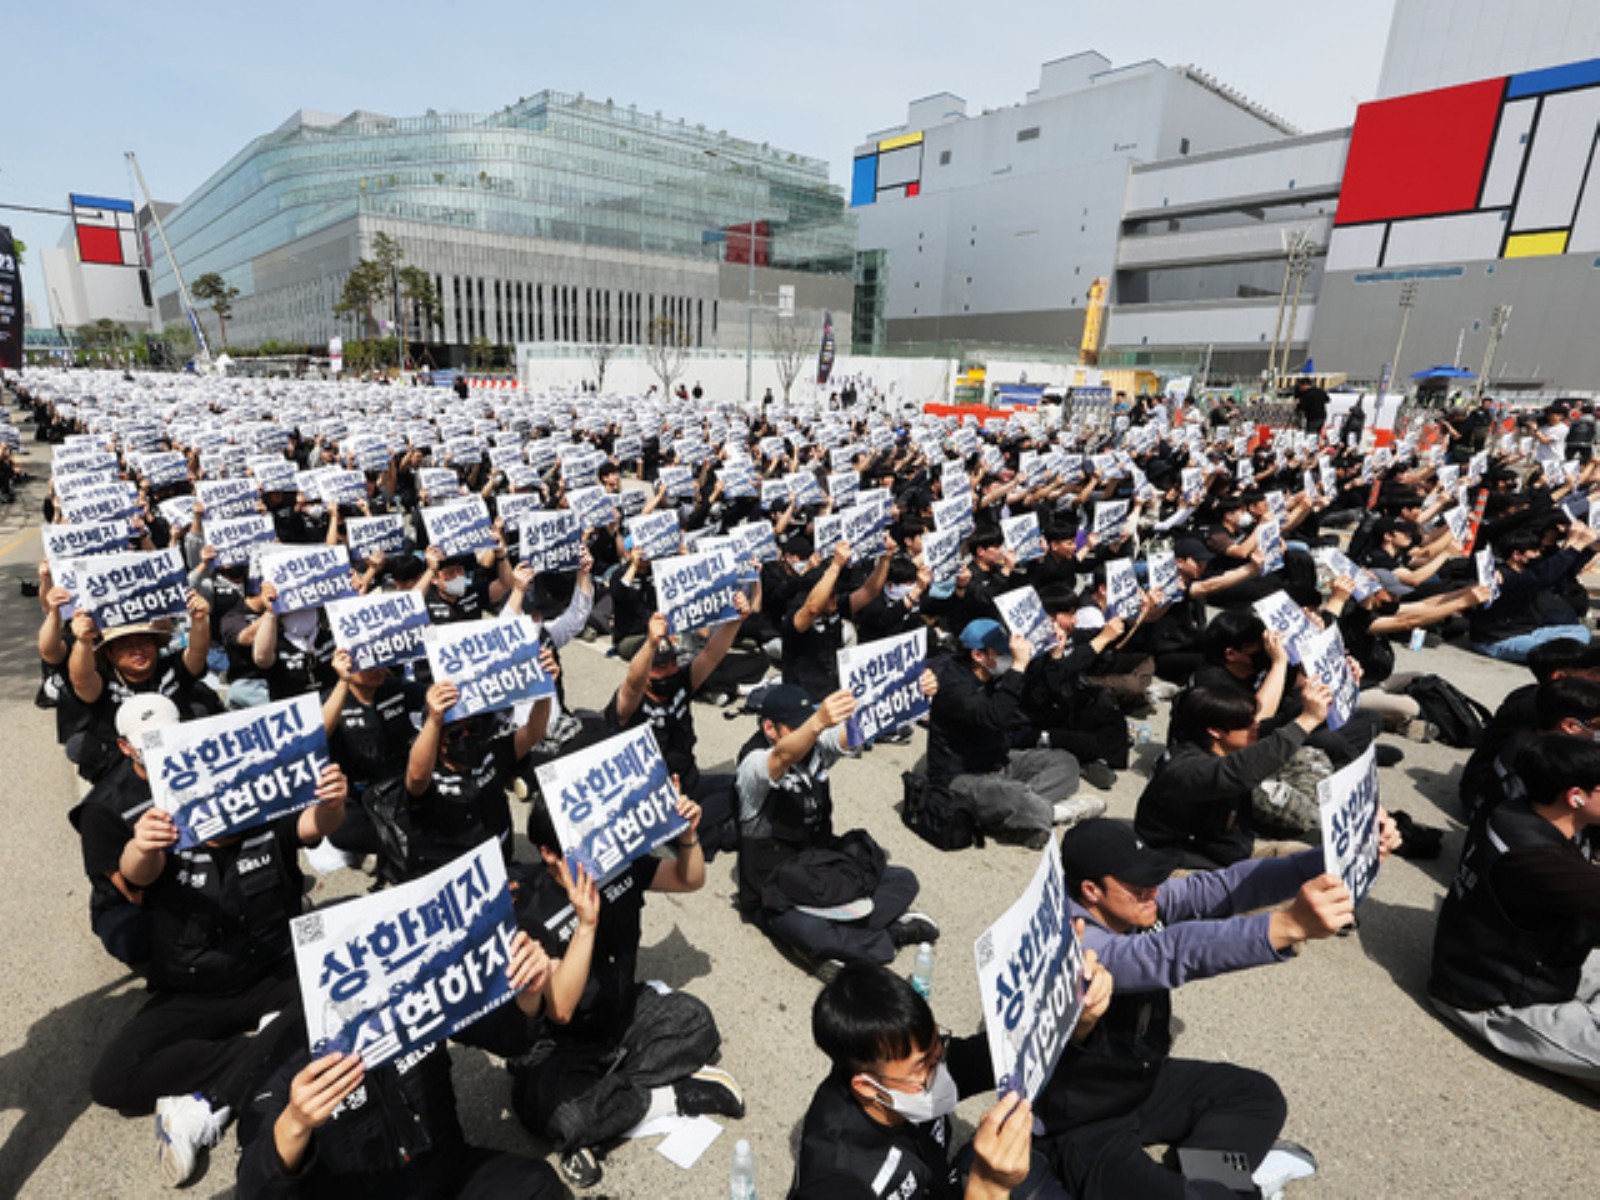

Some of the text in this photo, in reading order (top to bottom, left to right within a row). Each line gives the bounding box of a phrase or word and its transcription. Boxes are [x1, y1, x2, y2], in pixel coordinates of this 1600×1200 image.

[49, 523, 118, 554] 상한폐지
[273, 549, 338, 584] 상한폐지
[86, 552, 175, 598] 상한폐지
[102, 581, 189, 627] 실현하자
[660, 552, 726, 600] 상한폐지
[339, 593, 415, 638] 상한폐지
[438, 618, 526, 674] 상한폐지
[849, 633, 921, 698] 상한폐지
[459, 656, 546, 714] 실현하자
[160, 701, 305, 790] 상한폐지
[188, 750, 330, 843] 실현하자
[560, 726, 659, 824] 상한폐지
[591, 778, 682, 873] 실현하자
[319, 853, 491, 1003] 상한폐지
[353, 920, 518, 1071] 실현하자
